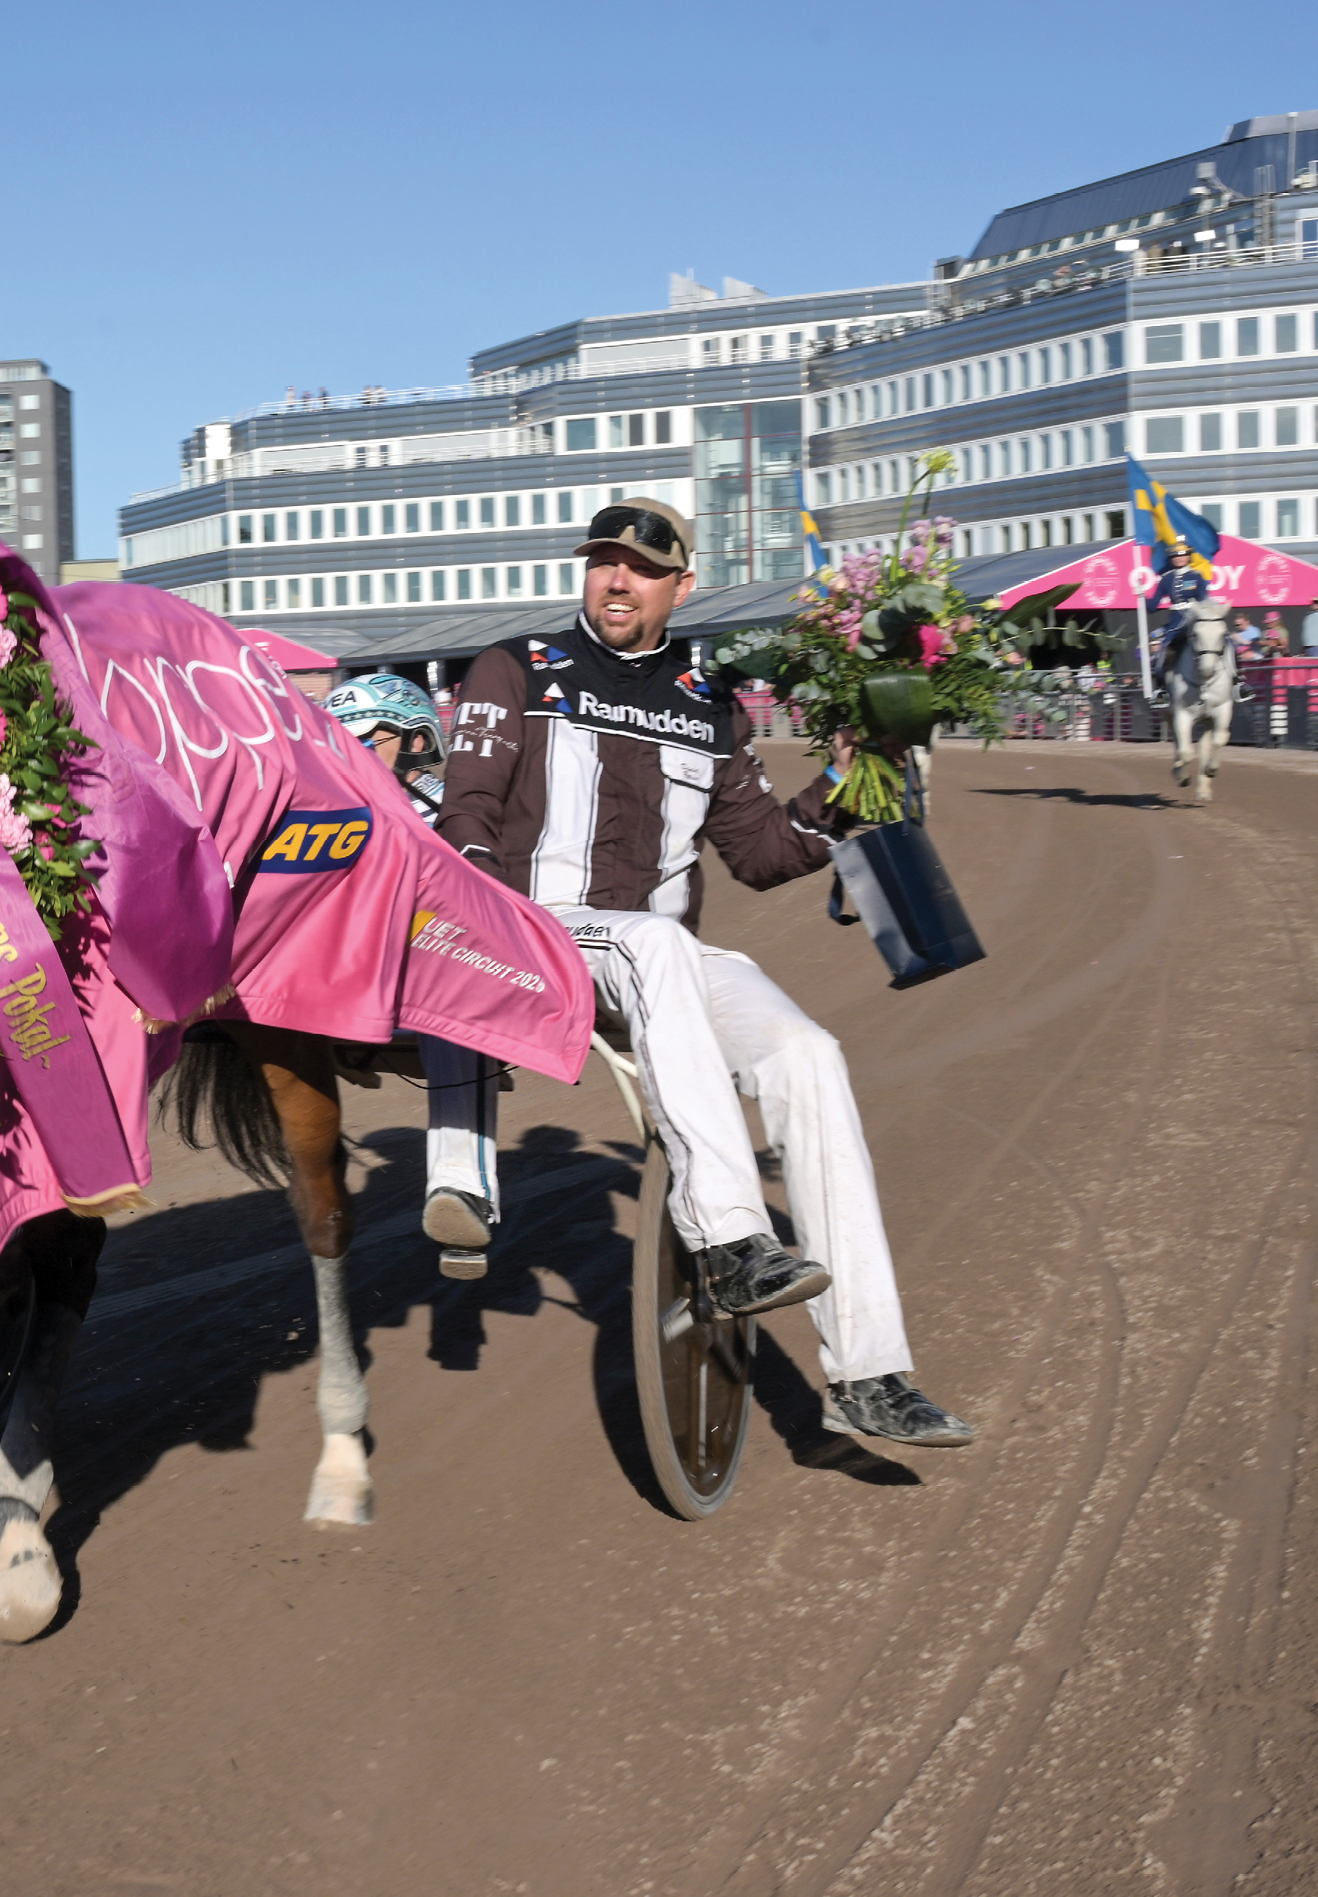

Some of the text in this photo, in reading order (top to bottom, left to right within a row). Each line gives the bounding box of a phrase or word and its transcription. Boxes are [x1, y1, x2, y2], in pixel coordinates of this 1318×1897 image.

[531, 658, 575, 671] Radden
[579, 690, 715, 743] Ramudden
[261, 821, 369, 861] ATG
[423, 917, 467, 941] UET
[411, 934, 457, 957] ELITE
[451, 947, 516, 980] CIRCUIT
